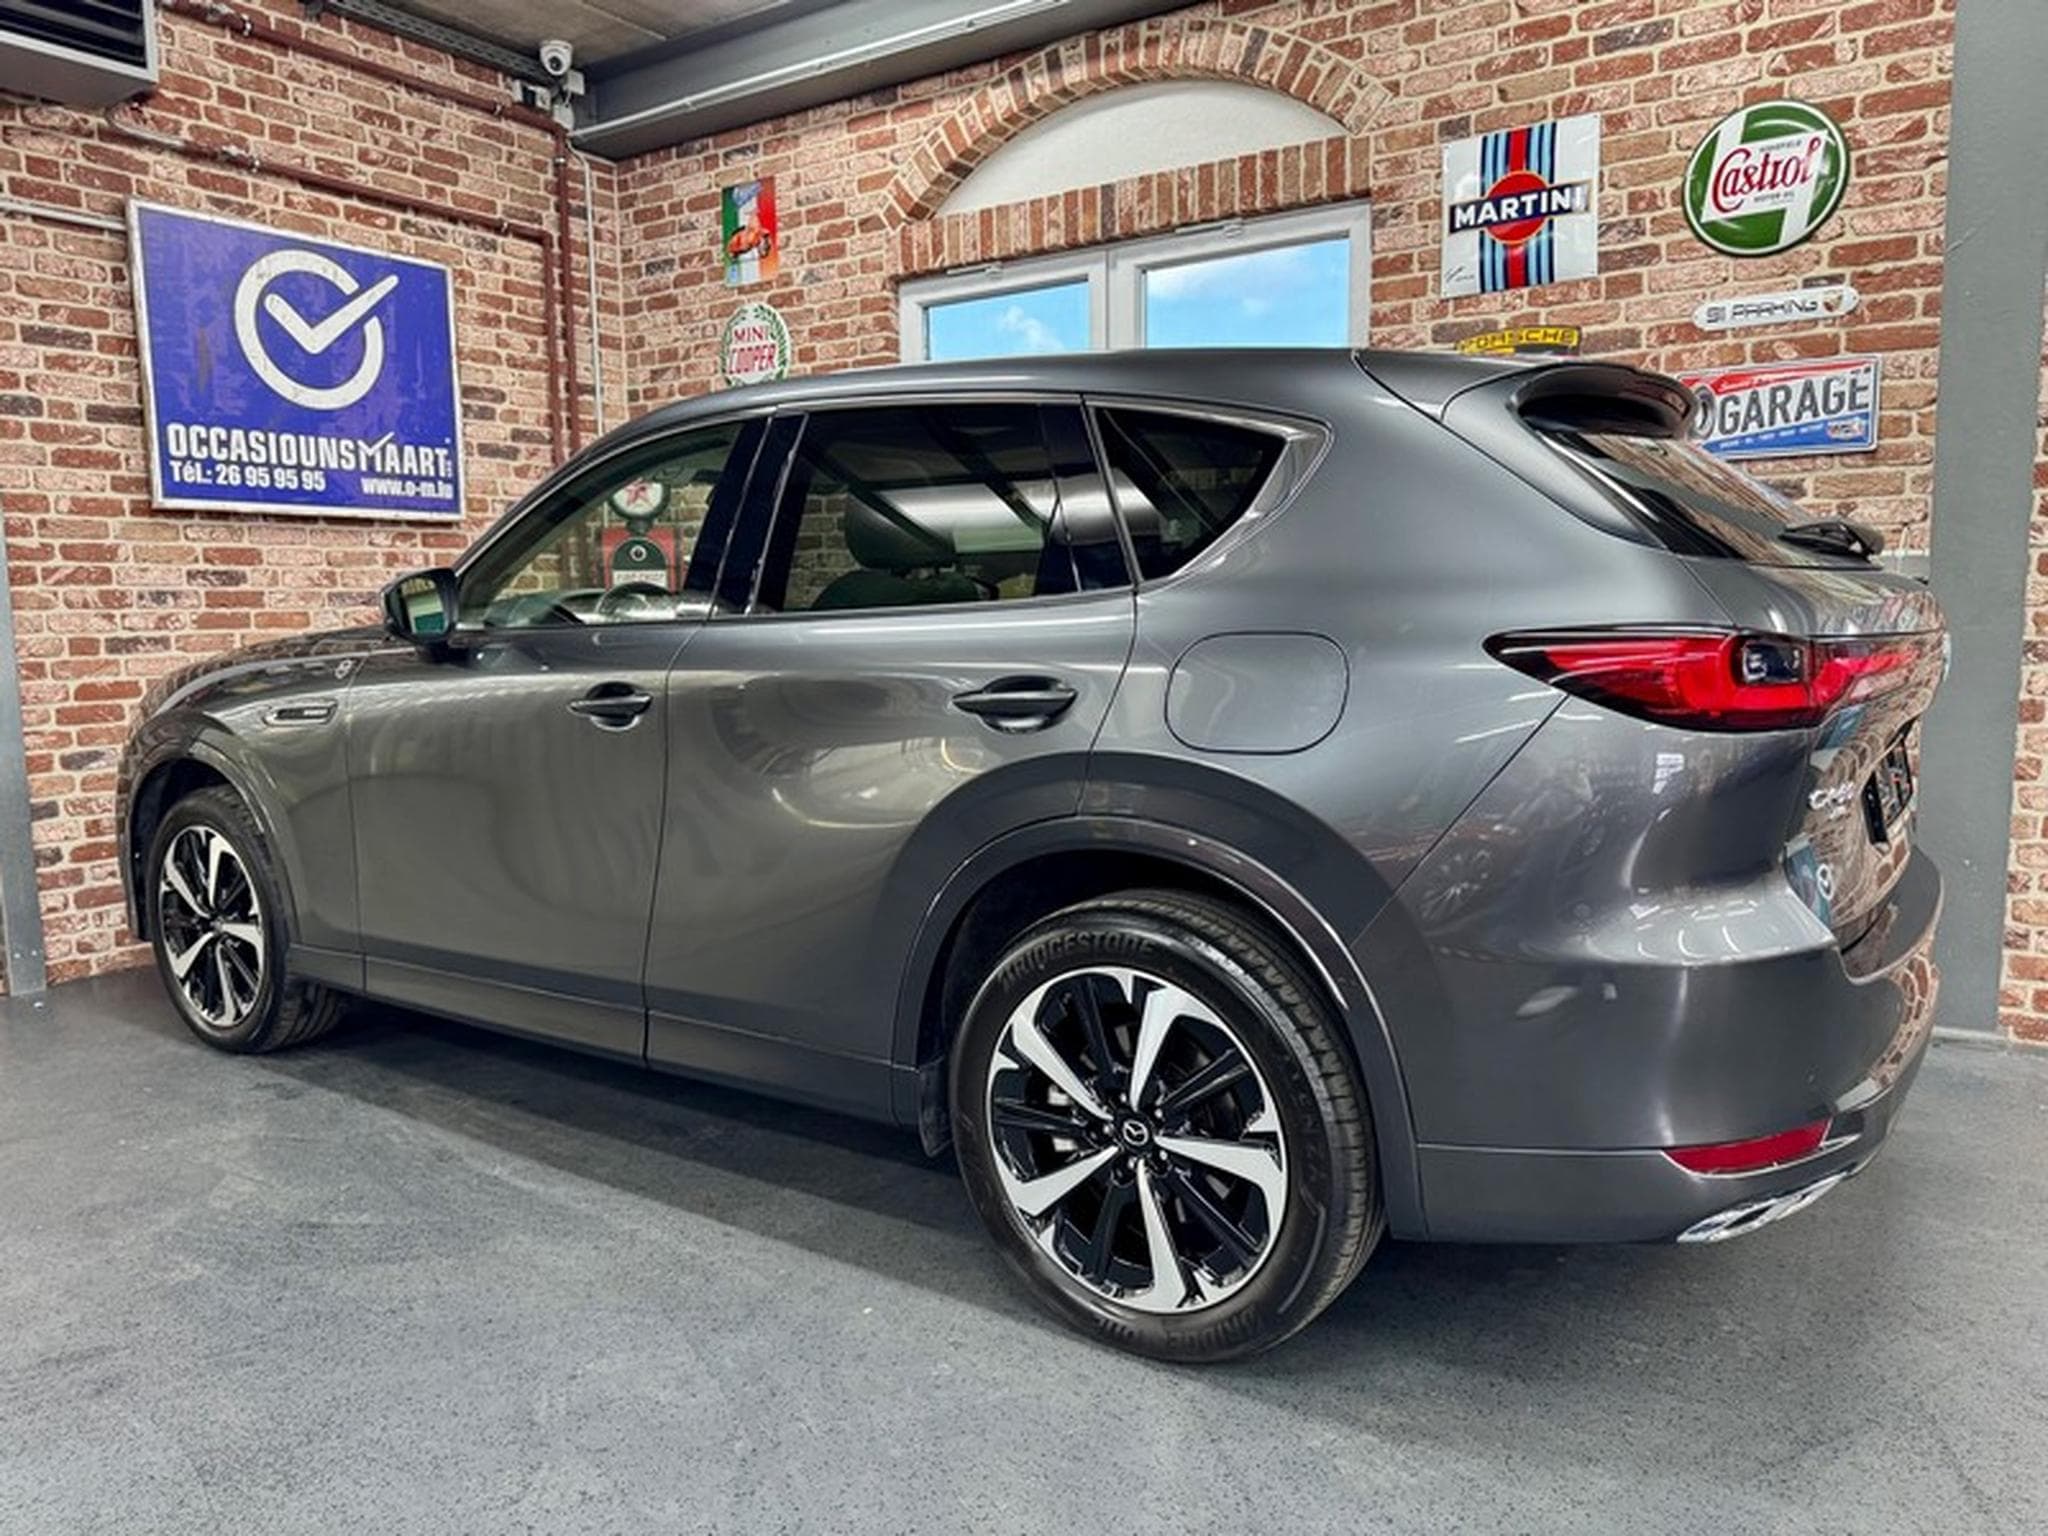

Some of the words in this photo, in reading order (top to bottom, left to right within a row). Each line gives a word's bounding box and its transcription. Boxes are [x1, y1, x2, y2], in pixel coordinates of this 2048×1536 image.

[1712, 136, 1821, 213] Castrol
[1454, 186, 1584, 229] MARTINI
[734, 326, 769, 341] MINI
[728, 343, 776, 374] COOPER
[1718, 367, 1870, 435] GARAGE
[215, 464, 241, 486] 26
[244, 466, 270, 488] 95
[273, 468, 299, 490] 95
[302, 471, 326, 491] 95
